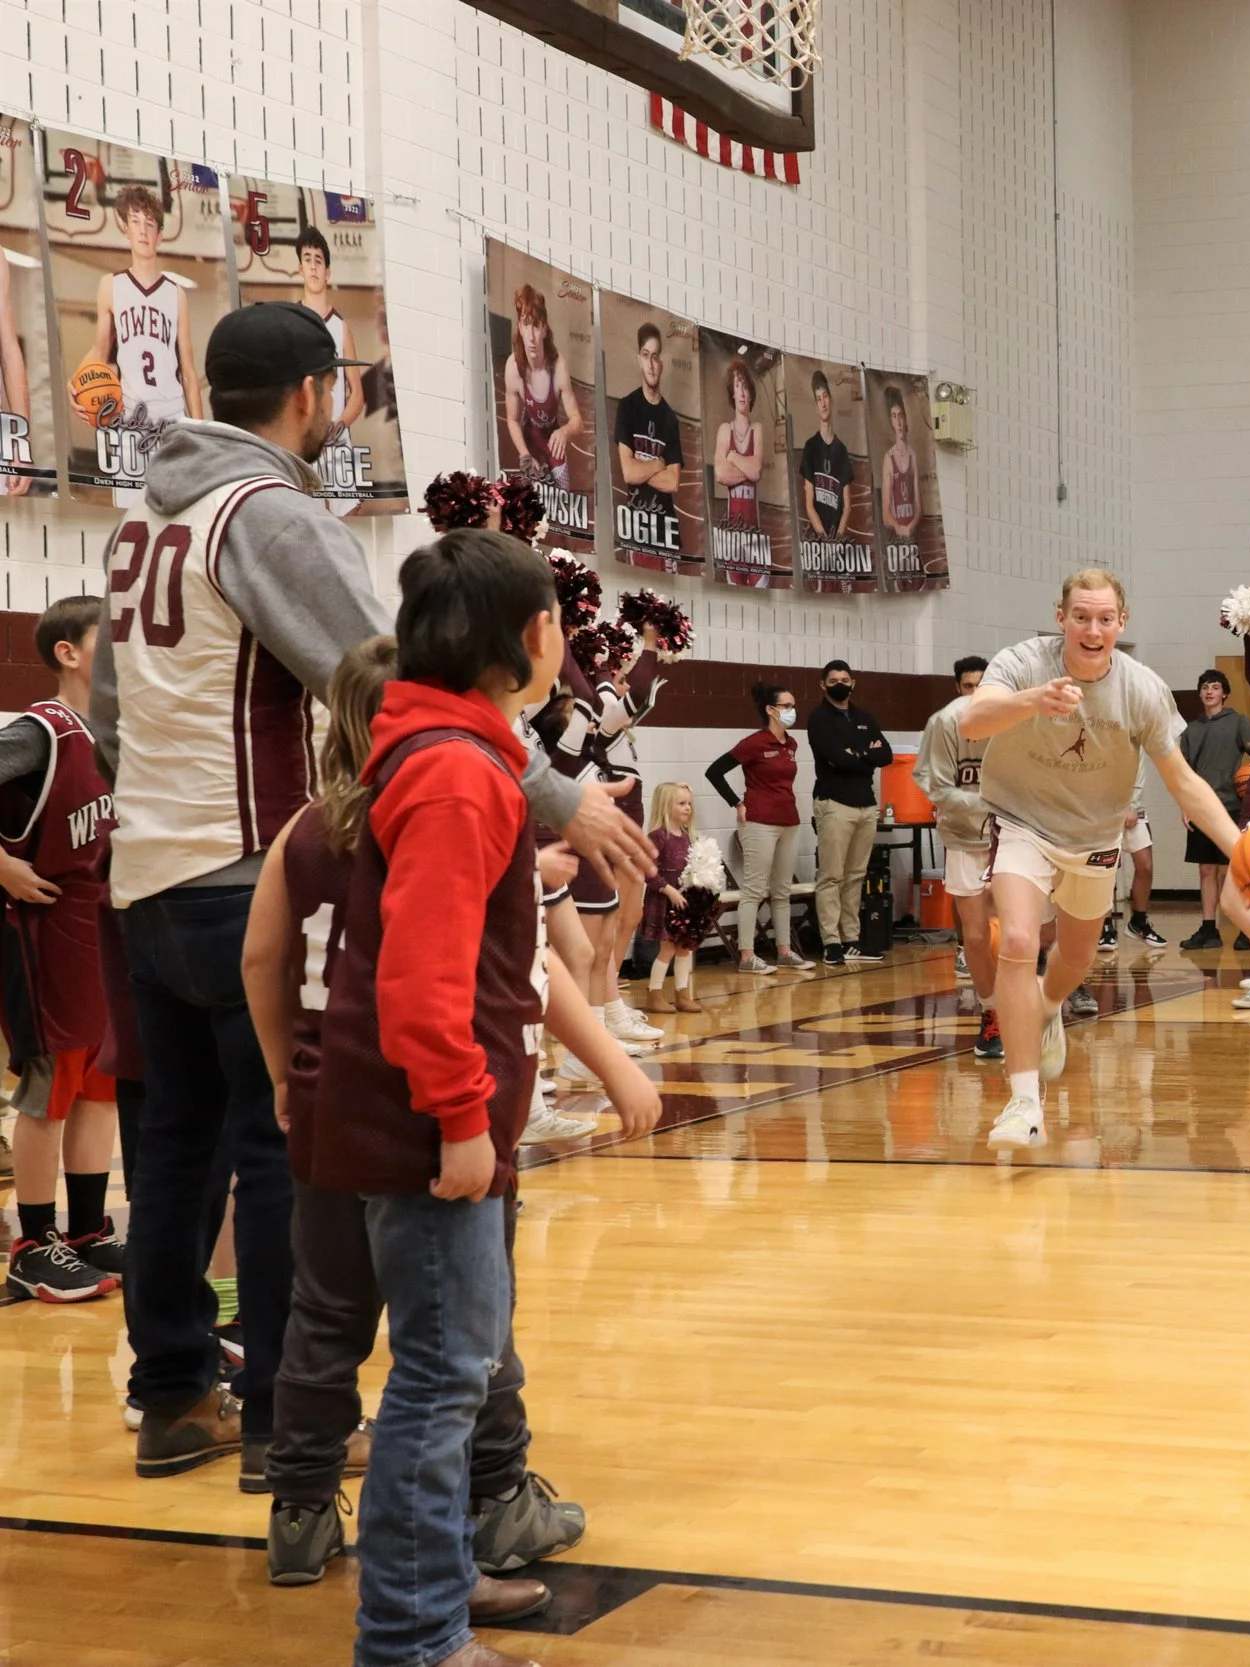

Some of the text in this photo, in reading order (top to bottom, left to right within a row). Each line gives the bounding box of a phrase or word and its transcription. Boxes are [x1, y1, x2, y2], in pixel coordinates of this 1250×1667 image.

[64, 148, 91, 221] 2
[246, 190, 270, 256] 5
[343, 203, 360, 214] 2022
[120, 305, 172, 349] OWEN
[142, 350, 158, 387] 2
[115, 480, 134, 488] HIGH
[616, 504, 680, 551] OGLE
[712, 526, 772, 567] NOONAN
[886, 544, 921, 573] ORR
[110, 521, 192, 648] 20
